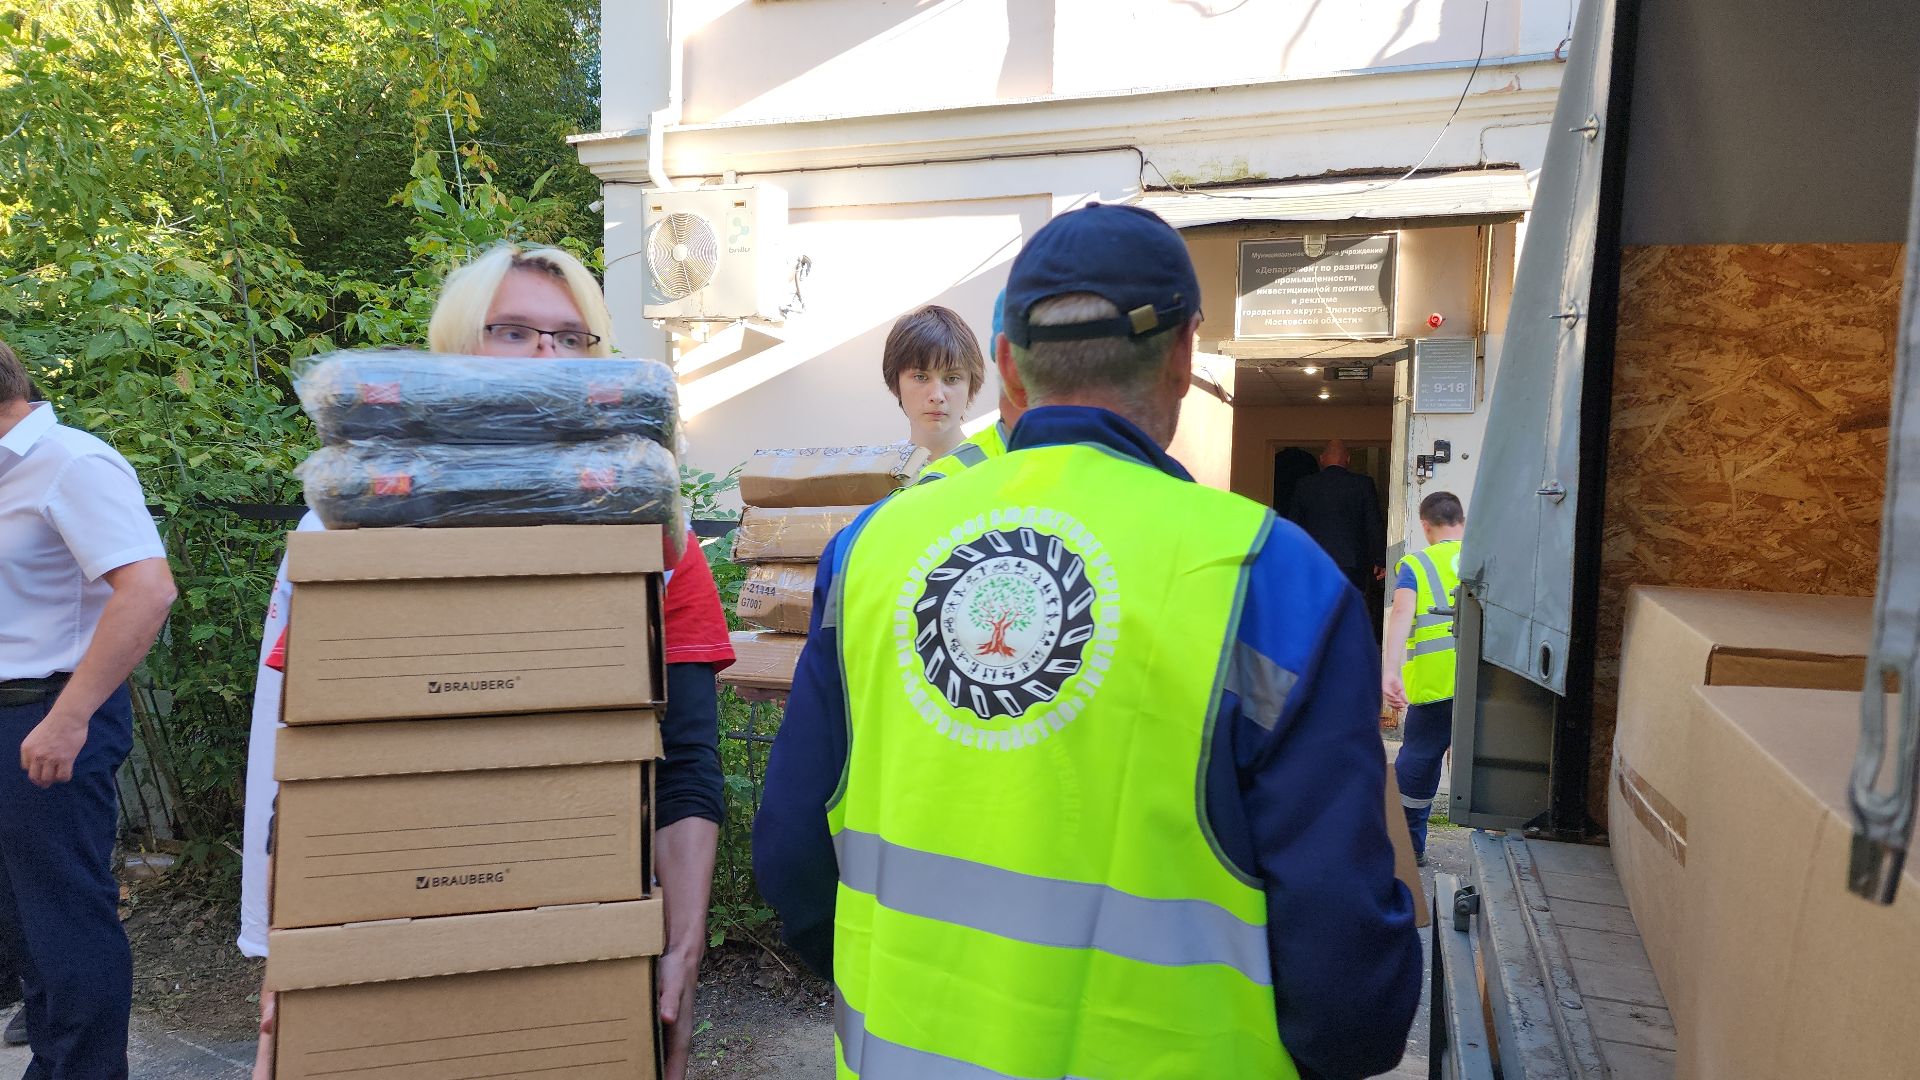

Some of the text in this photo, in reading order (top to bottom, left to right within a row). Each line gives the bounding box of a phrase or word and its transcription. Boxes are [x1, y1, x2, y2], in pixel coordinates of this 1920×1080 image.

[1340, 247, 1384, 257] учреждение
[1333, 263, 1378, 273] развитию
[1256, 284, 1375, 296] инвестиционной политике
[1299, 297, 1338, 305] рекламе
[1242, 308, 1291, 317] городского
[1293, 307, 1322, 316] округа
[1264, 317, 1318, 326] Московской
[443, 678, 516, 693] BRAUBERG
[431, 871, 505, 888] BRAUBERG
